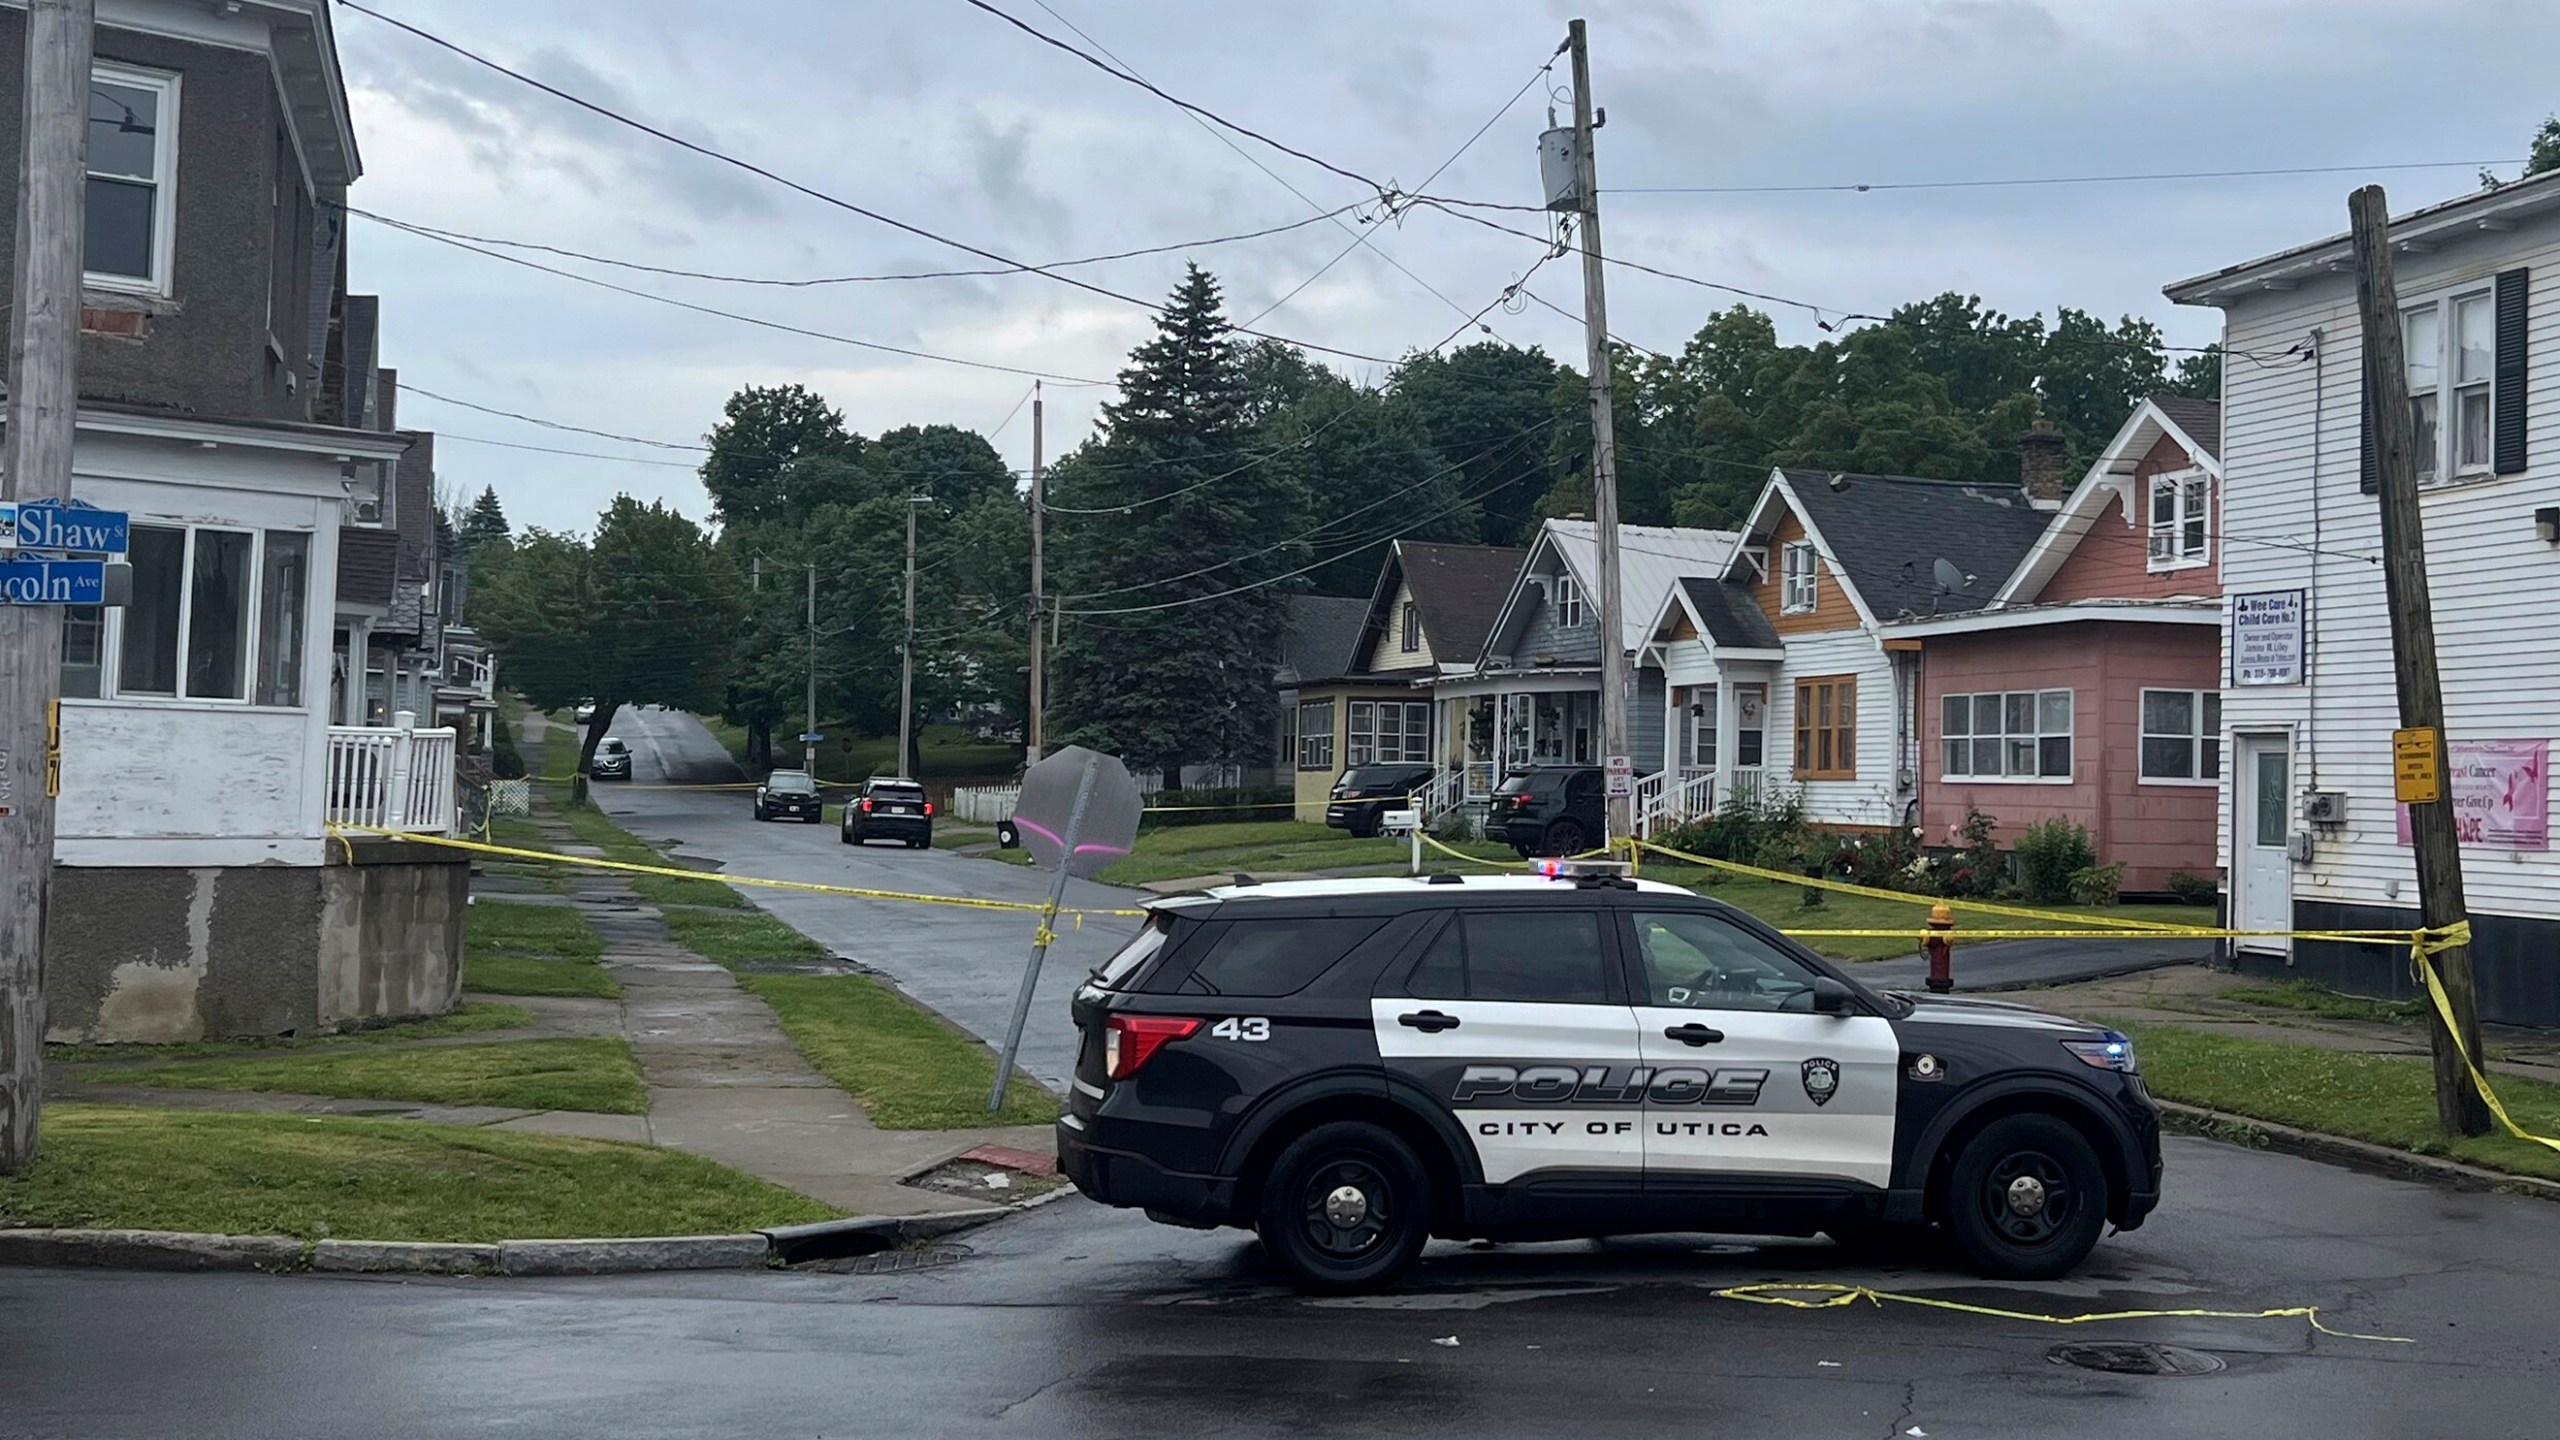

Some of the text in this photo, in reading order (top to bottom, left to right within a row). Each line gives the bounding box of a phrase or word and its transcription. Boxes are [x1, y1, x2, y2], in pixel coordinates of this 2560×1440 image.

[19, 509, 110, 549] Shaw
[114, 525, 124, 538] St
[0, 563, 99, 601] coln Ave
[2250, 599, 2286, 611] Wee Care
[2239, 613, 2260, 626] Child
[2262, 613, 2280, 624] Care
[1613, 758, 1624, 766] NO
[2469, 764, 2496, 777] Cancer
[1211, 1017, 1270, 1041] 43
[1803, 1060, 1838, 1071] POLICE
[1452, 1066, 1770, 1105] POLICE
[1478, 1122, 1769, 1137] CITY OF UTICA
